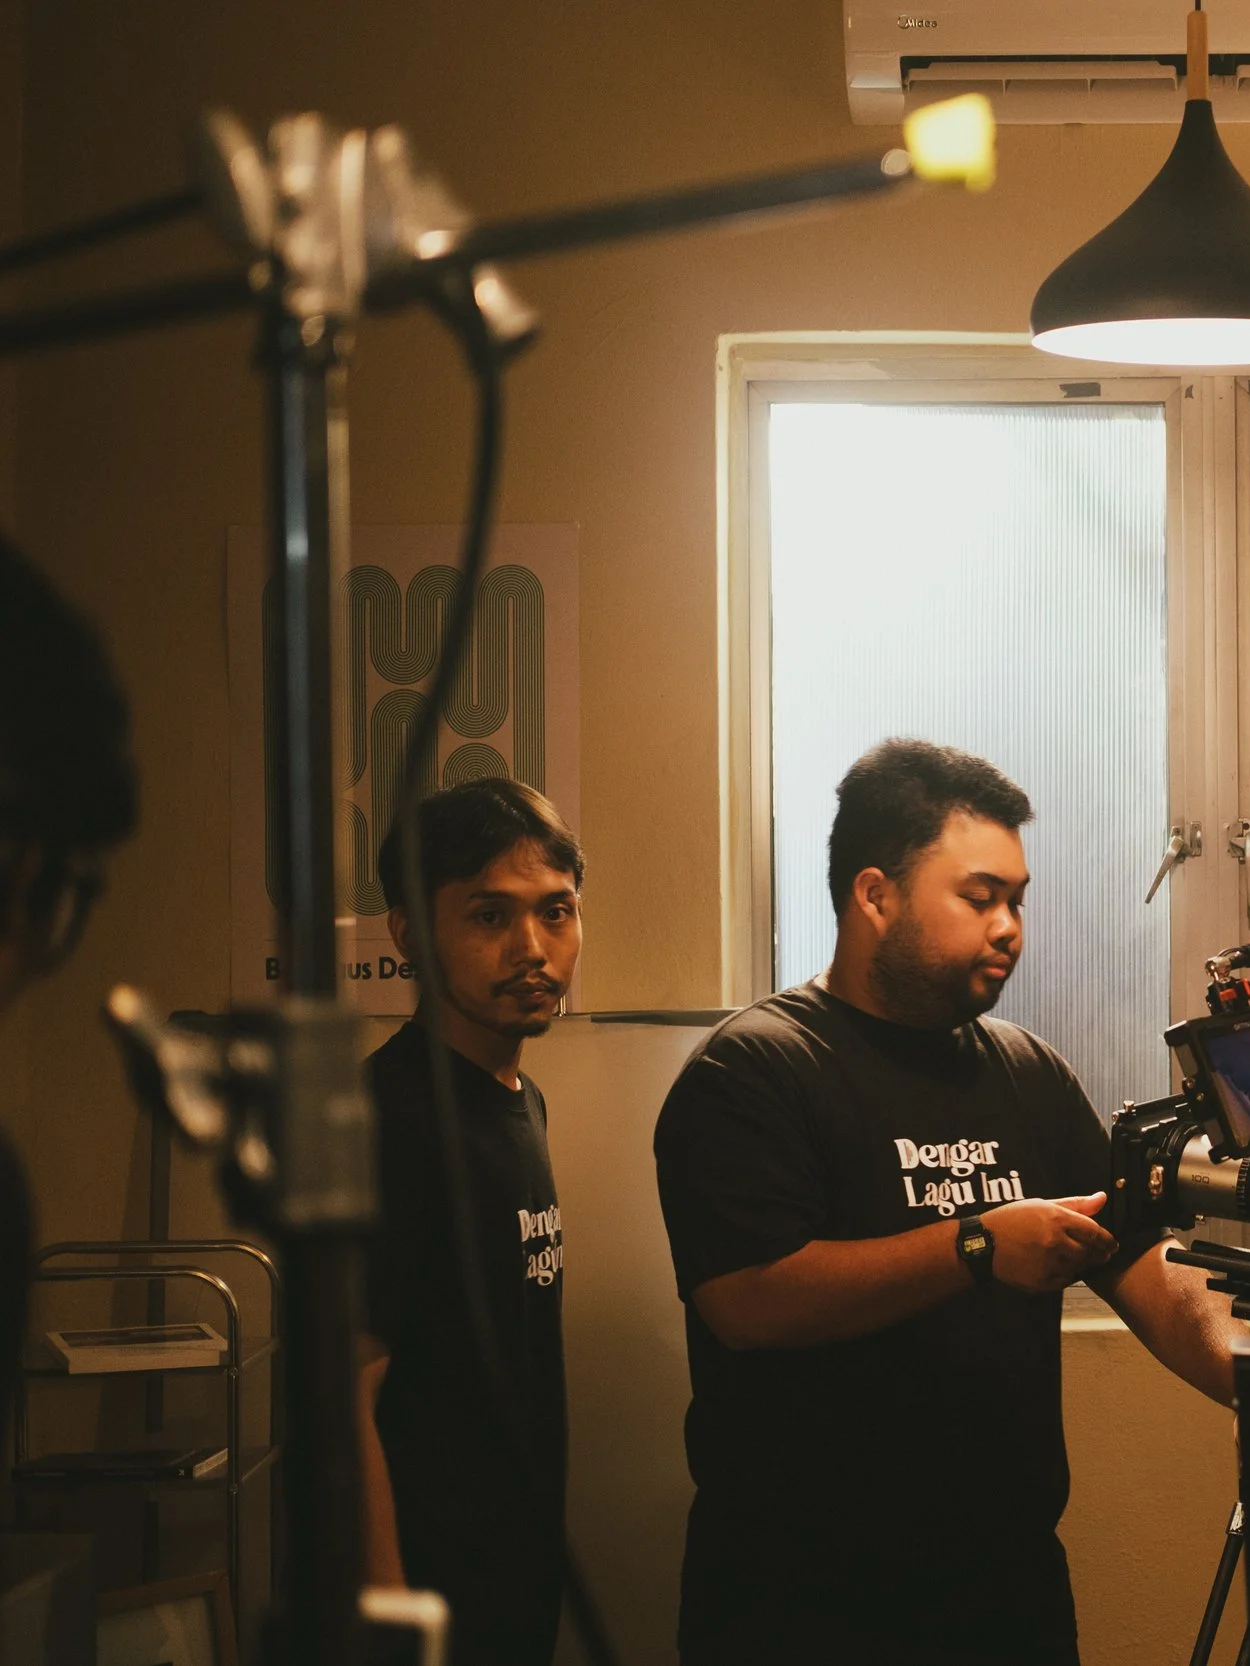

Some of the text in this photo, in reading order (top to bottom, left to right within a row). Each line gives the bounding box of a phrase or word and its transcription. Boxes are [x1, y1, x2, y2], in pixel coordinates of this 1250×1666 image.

[902, 17, 938, 28] Midea
[894, 1138, 999, 1177] Dengar
[903, 1170, 1025, 1216] Lagu Ini
